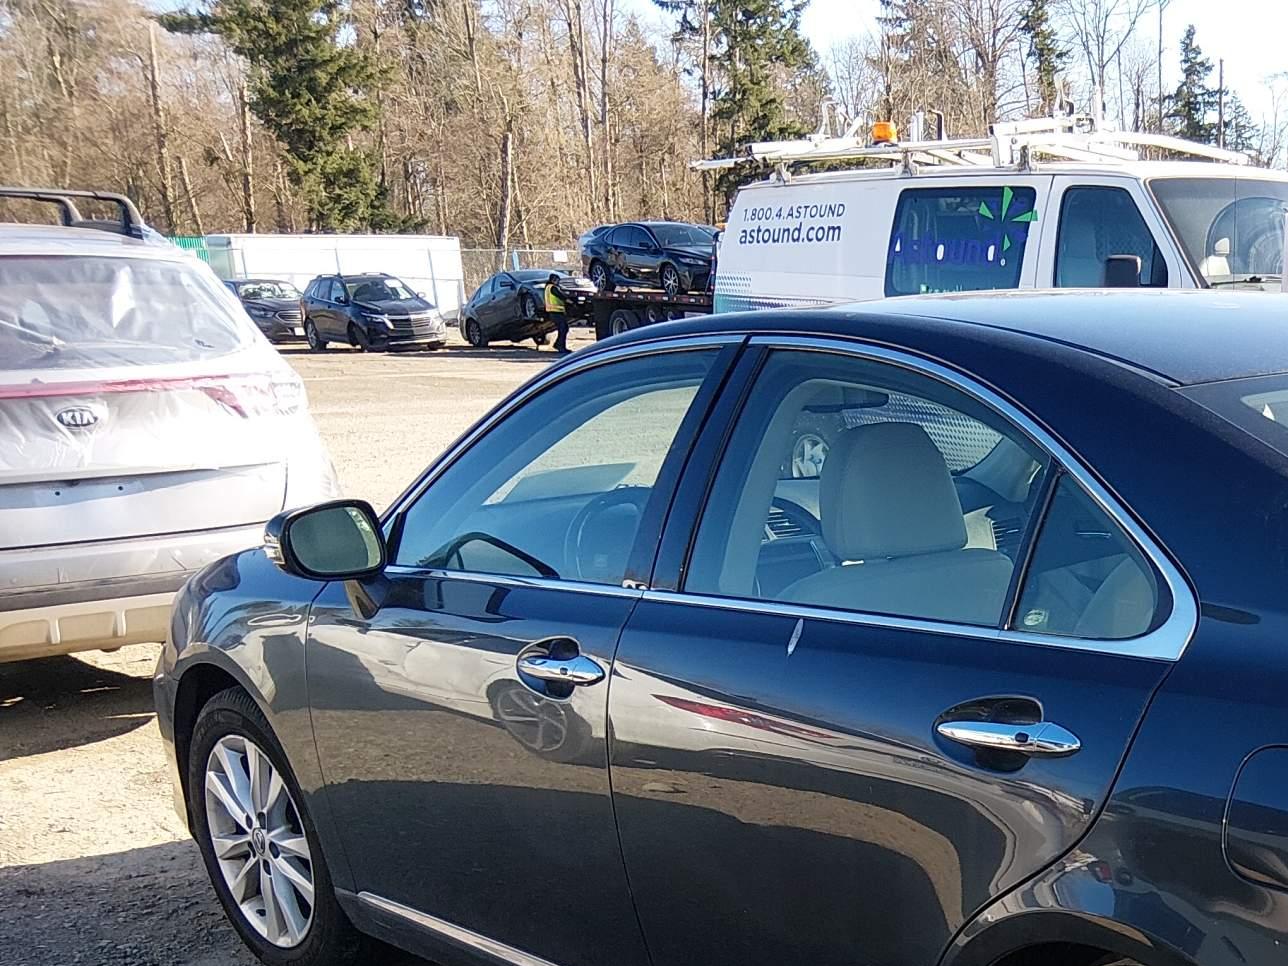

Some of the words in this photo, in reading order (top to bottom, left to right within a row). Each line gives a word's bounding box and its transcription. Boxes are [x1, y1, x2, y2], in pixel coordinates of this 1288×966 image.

[743, 203, 845, 222] 1.800.4.ASTOUND
[739, 221, 841, 244] astound.com
[61, 411, 95, 425] KIA
